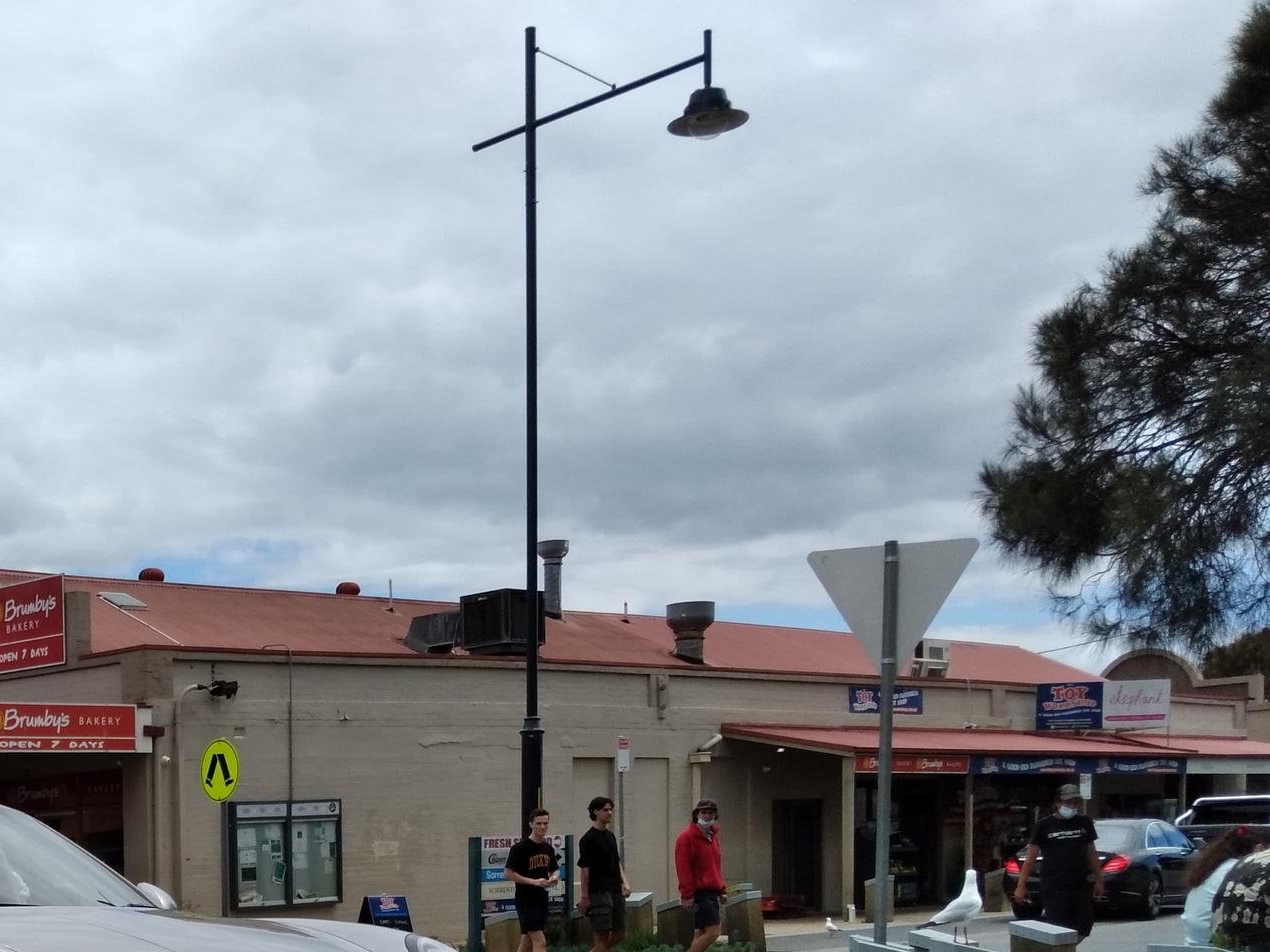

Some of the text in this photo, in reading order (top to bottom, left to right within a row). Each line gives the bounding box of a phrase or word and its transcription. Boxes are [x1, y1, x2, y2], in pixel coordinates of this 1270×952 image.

[4, 594, 57, 622] Brumby's
[6, 620, 40, 634] BAKERY
[21, 648, 27, 660] 7
[30, 646, 48, 658] DAYS
[1051, 686, 1089, 702] TOY
[3, 709, 121, 734] Brumby's BAKERY
[50, 740, 60, 749] 7
[68, 740, 104, 749] DAYS
[484, 838, 512, 849] FRESH
